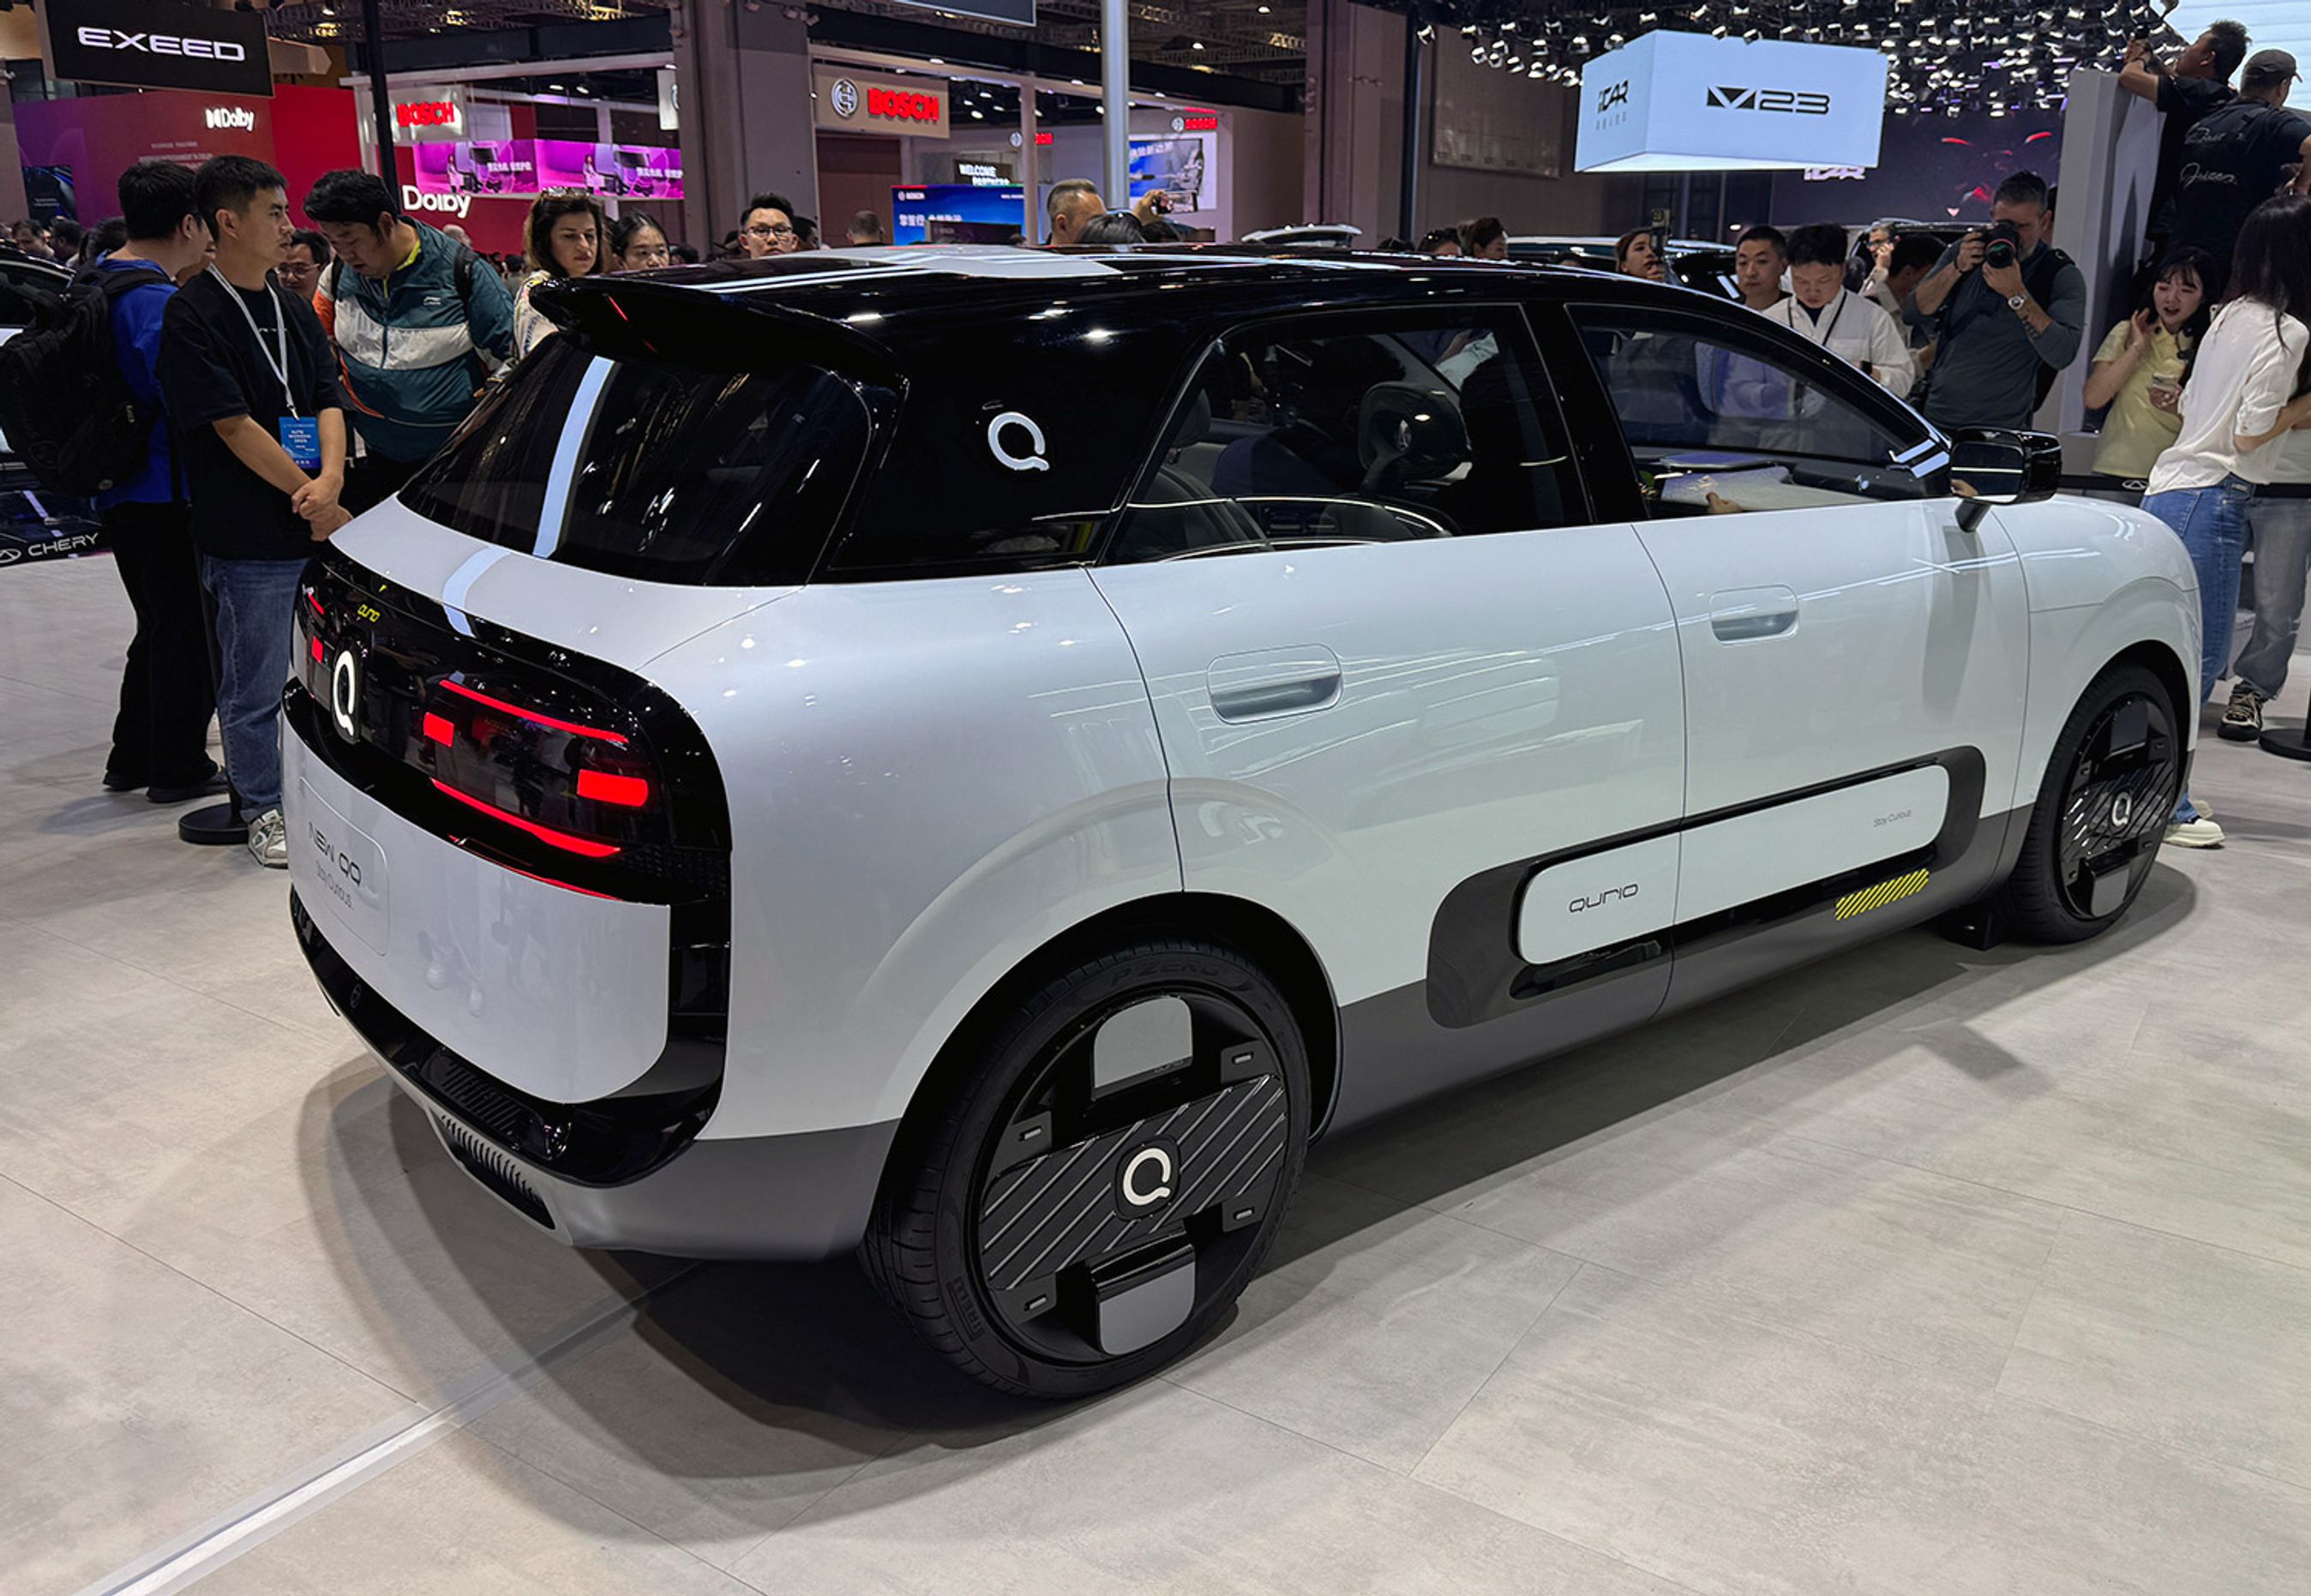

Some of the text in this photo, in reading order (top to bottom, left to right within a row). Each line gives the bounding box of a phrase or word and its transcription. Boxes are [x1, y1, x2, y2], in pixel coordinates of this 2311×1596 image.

[77, 26, 245, 62] EXEED
[220, 107, 255, 132] Dolby
[397, 101, 455, 127] BOSCH
[867, 87, 939, 123] BOSCH
[402, 184, 471, 219] Dolby
[27, 532, 99, 557] CHERY
